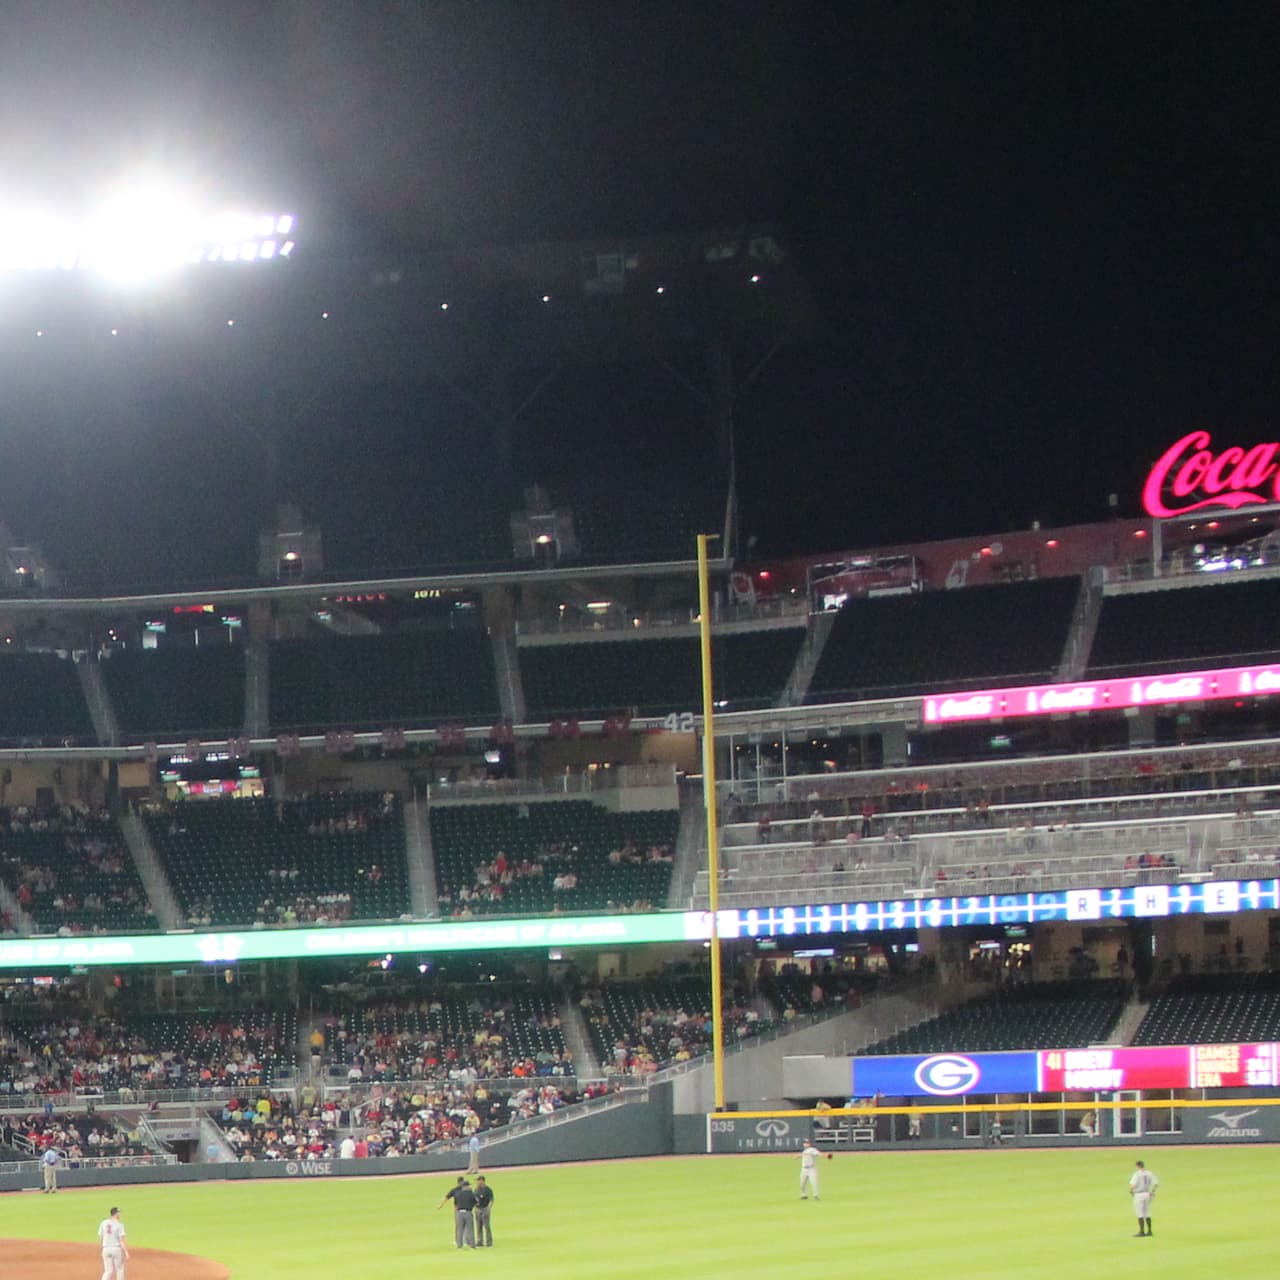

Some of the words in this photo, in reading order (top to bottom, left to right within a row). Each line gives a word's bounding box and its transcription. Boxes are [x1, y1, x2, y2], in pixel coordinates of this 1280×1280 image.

[664, 712, 696, 734] 42
[915, 1055, 980, 1095] G
[711, 1120, 735, 1133] 335
[738, 1138, 808, 1149] INFINIT
